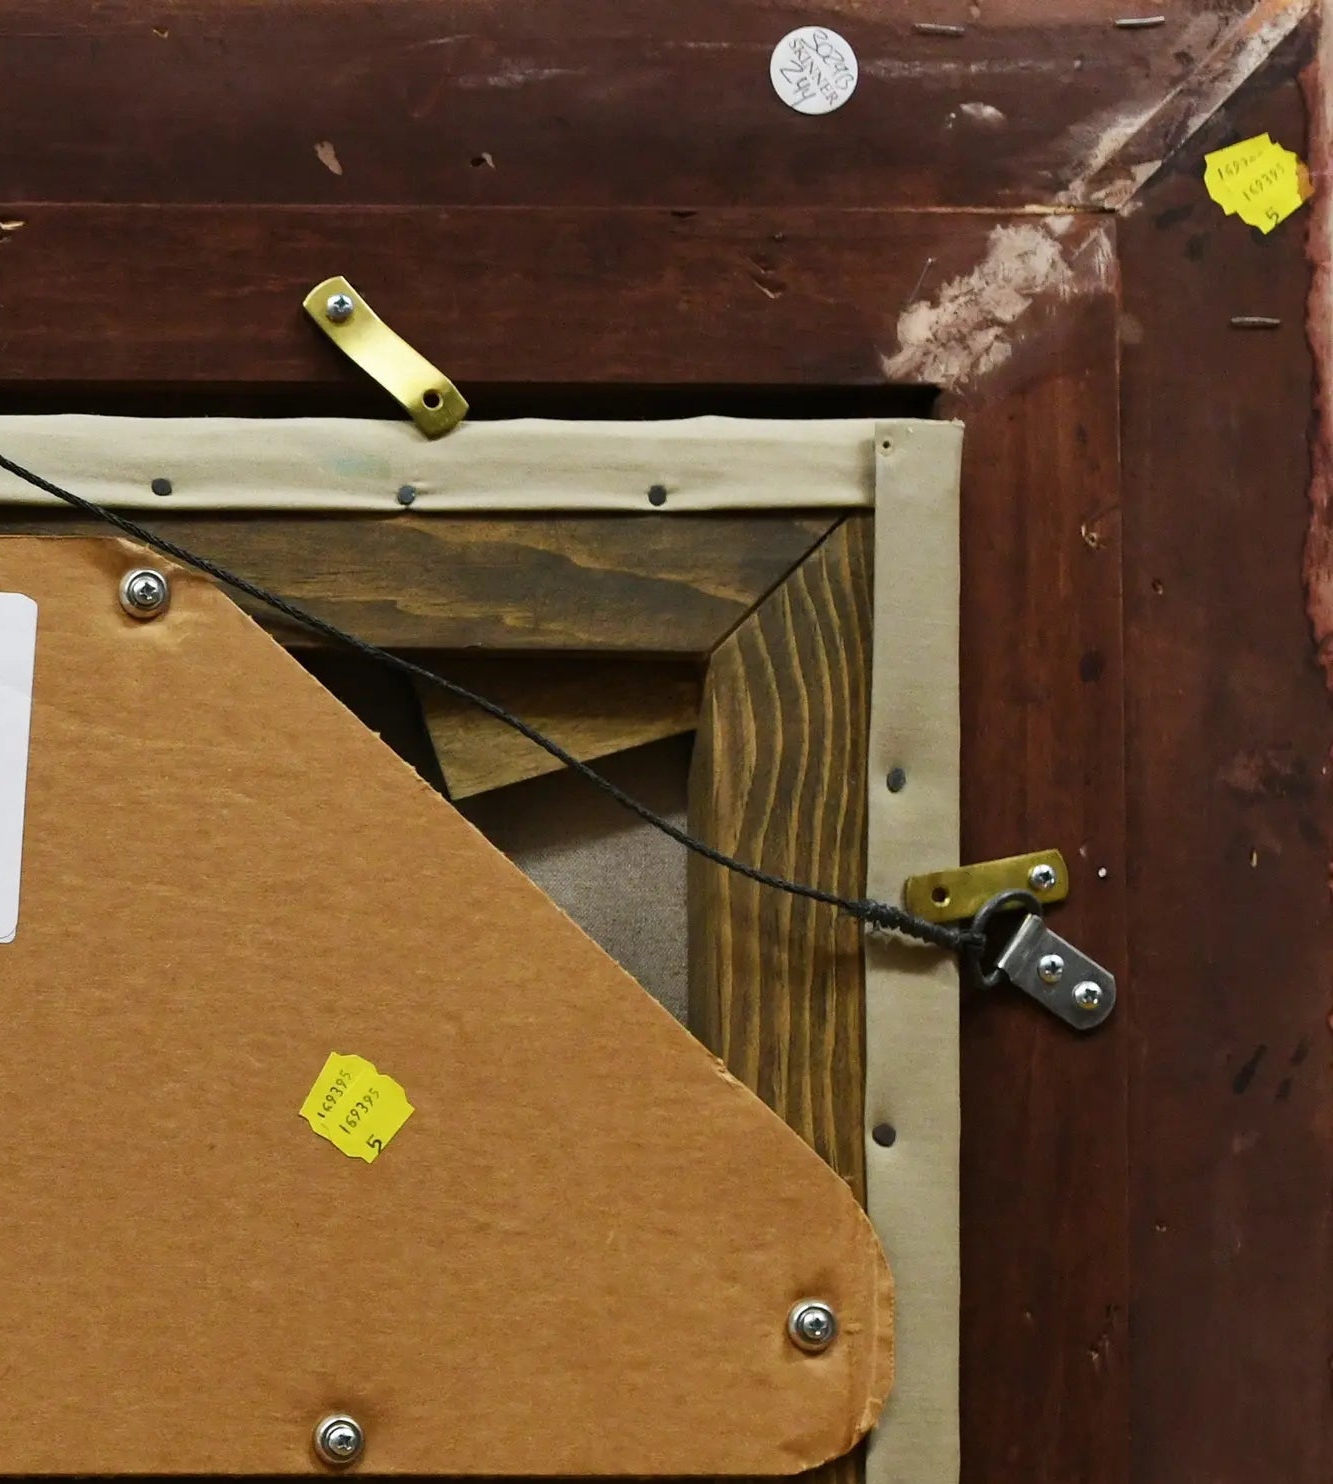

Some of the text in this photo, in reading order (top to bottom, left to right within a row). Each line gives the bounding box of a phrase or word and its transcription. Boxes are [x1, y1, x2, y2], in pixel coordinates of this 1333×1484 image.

[789, 40, 839, 105] SKINNER
[1264, 206, 1280, 226] 5
[316, 1069, 352, 1118] 169395
[338, 1087, 380, 1135] 169395
[366, 1133, 382, 1155] 5
